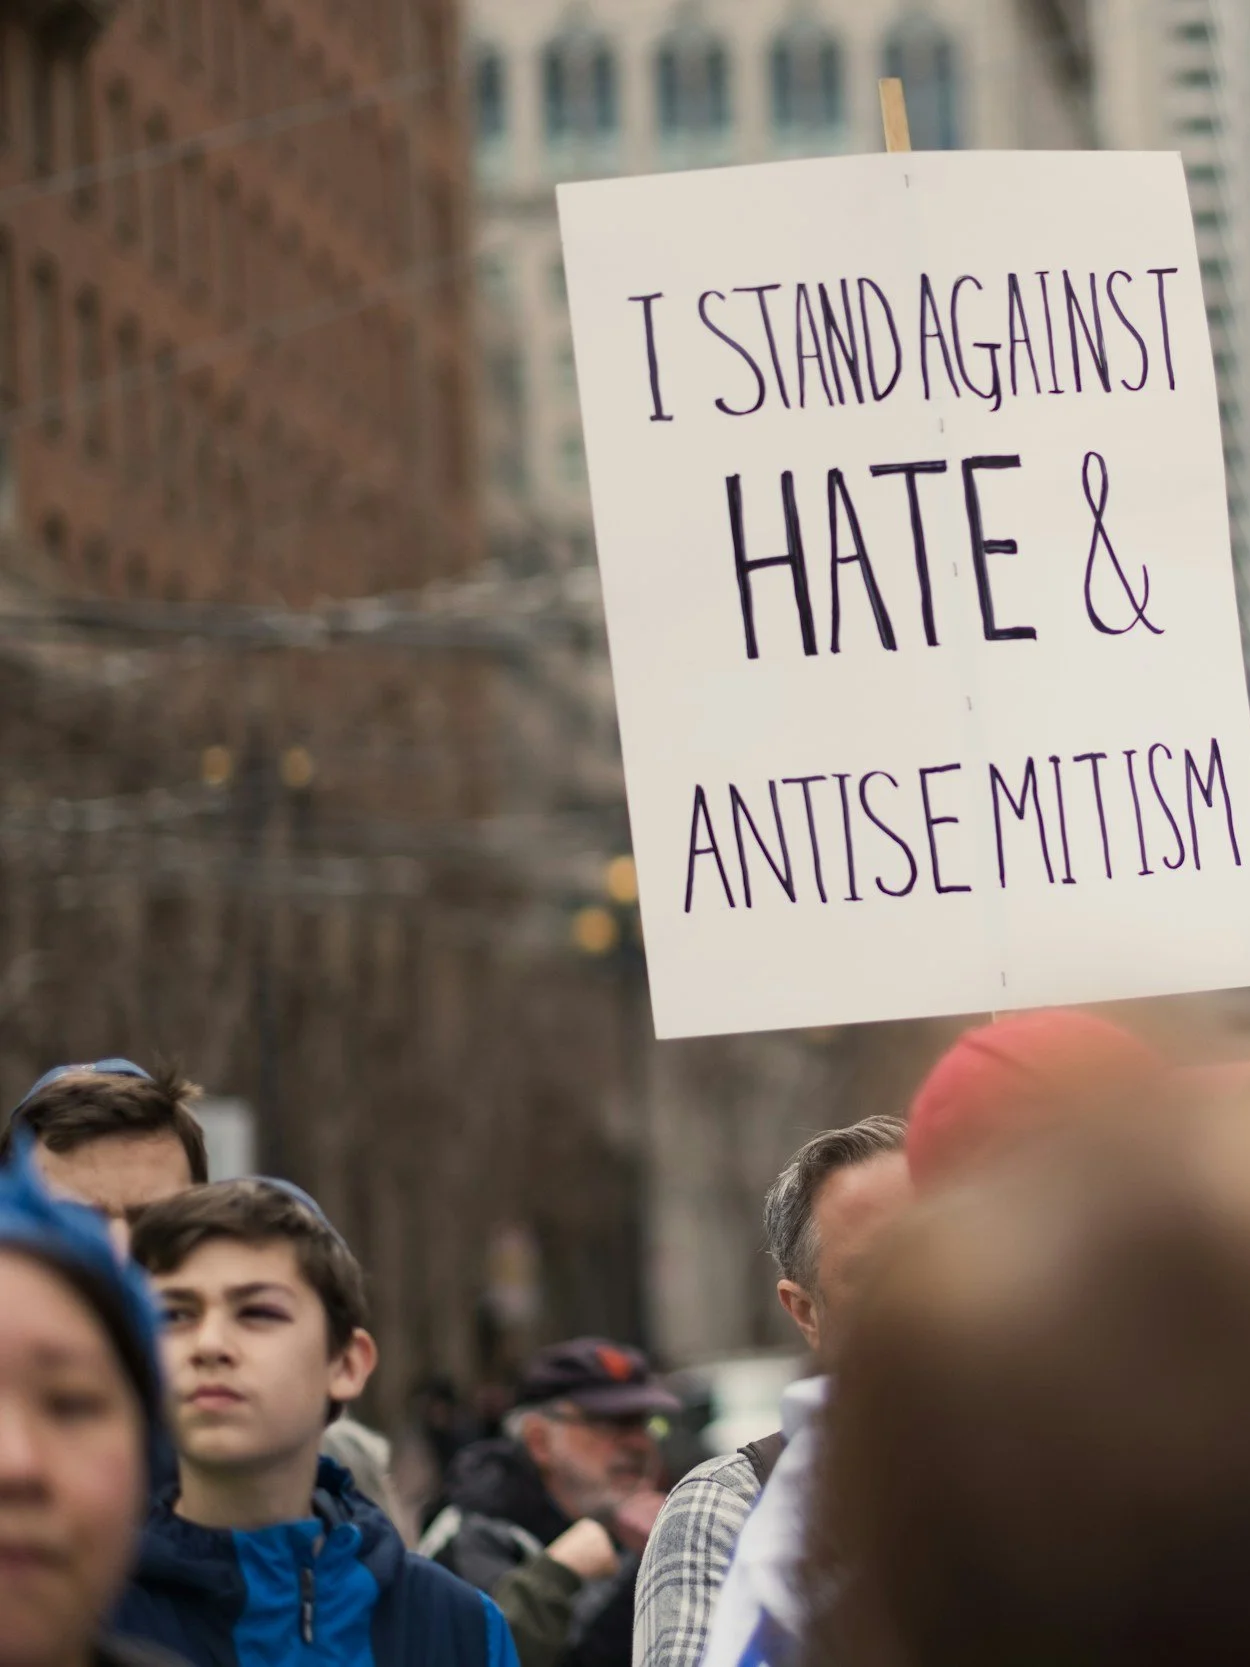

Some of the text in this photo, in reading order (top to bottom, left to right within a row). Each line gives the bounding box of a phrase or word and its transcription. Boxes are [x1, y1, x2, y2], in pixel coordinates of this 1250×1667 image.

[628, 267, 1179, 422] I STAND AGAINST
[724, 450, 1165, 661] HATE &
[684, 737, 1242, 914] ANTISEMITISM
